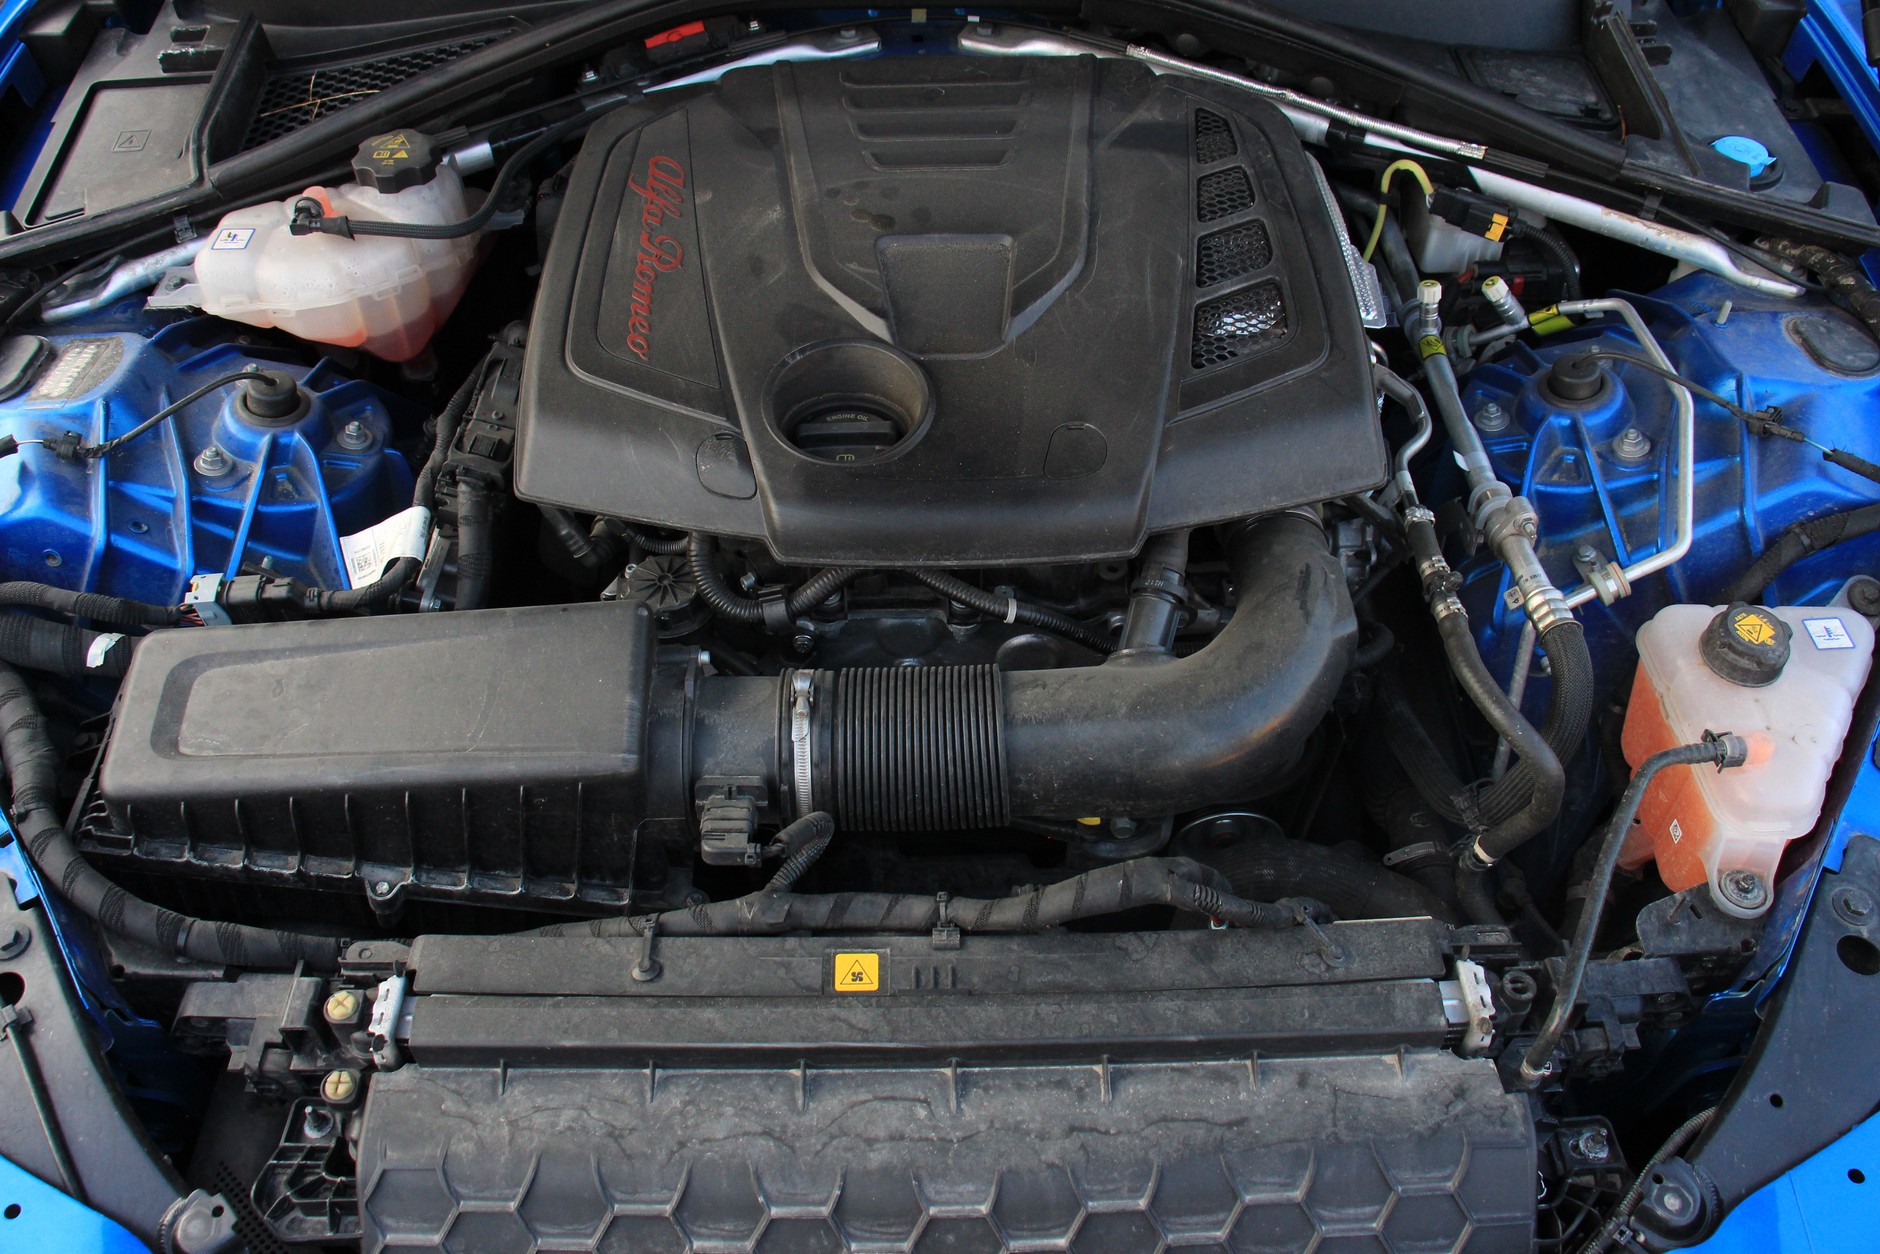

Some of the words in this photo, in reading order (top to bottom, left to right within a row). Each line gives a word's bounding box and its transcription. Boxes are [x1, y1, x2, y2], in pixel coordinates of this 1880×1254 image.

[628, 155, 686, 229] Alfa
[627, 230, 684, 361] Romeo
[826, 413, 856, 421] ENGINE
